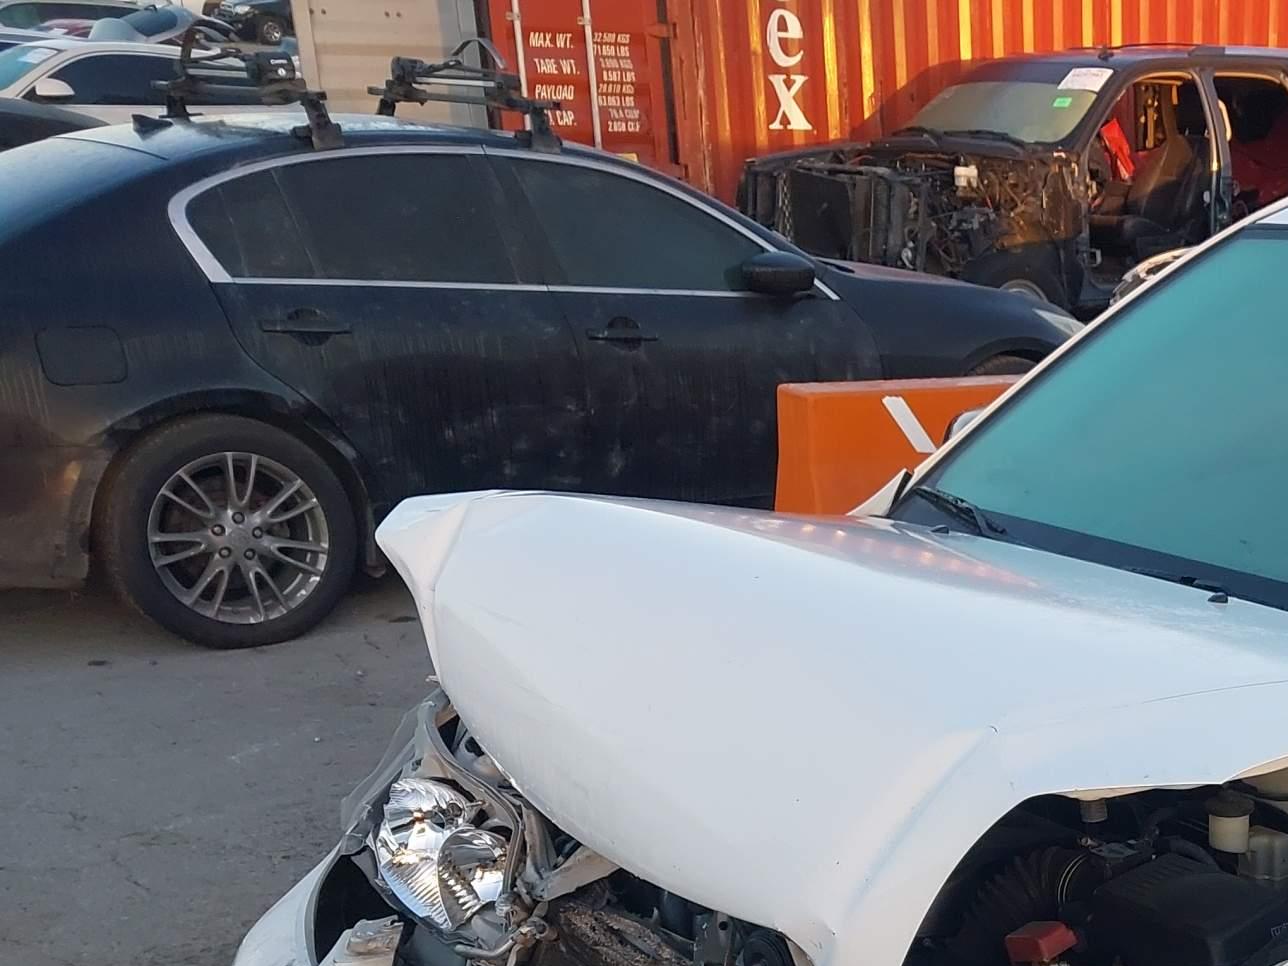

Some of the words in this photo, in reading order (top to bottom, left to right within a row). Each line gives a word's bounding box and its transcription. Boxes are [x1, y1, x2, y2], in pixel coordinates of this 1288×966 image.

[528, 31, 554, 48] MAX.
[556, 33, 574, 49] WT.
[533, 58, 559, 74] TARE
[560, 59, 580, 75] WT.
[766, 0, 813, 130] ex
[535, 84, 575, 100] PAYLOAD
[556, 110, 577, 126] CAP.
